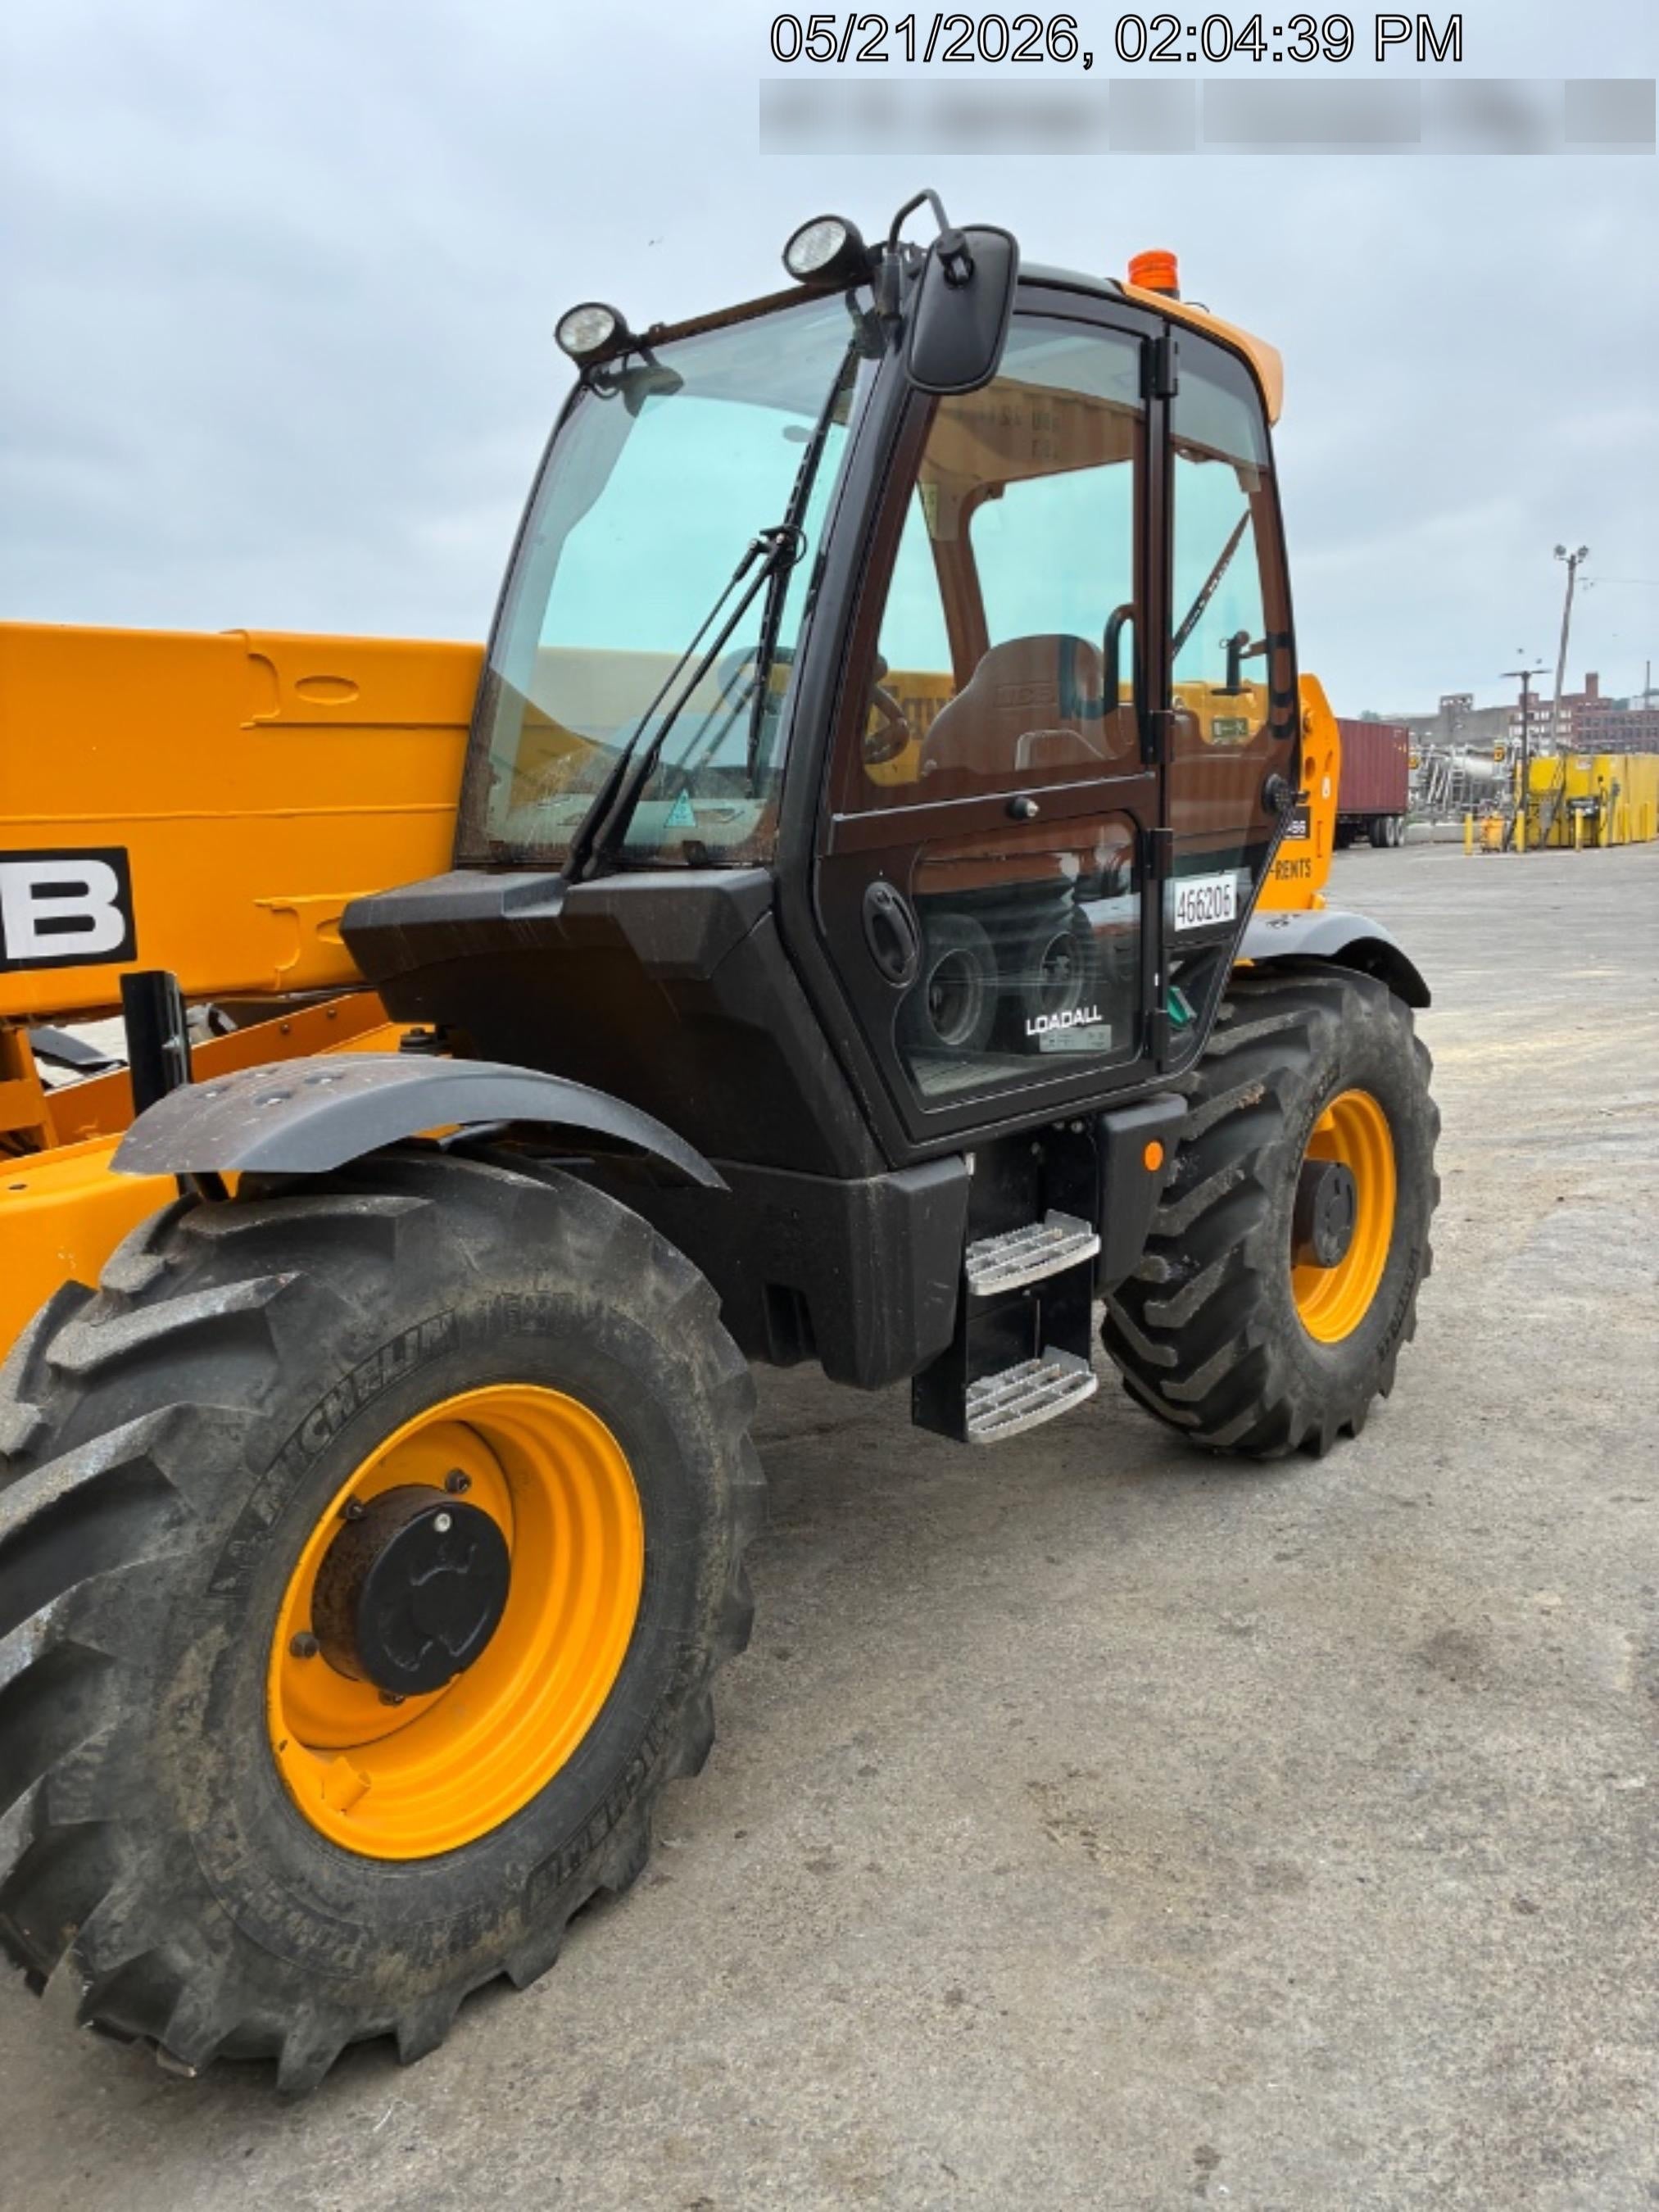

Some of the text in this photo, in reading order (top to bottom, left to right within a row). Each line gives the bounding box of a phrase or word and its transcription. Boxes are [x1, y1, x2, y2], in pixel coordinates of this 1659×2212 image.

[0, 860, 126, 959] B
[1026, 1004, 1103, 1036] LOADALL
[242, 1311, 457, 1527] MICHELIN
